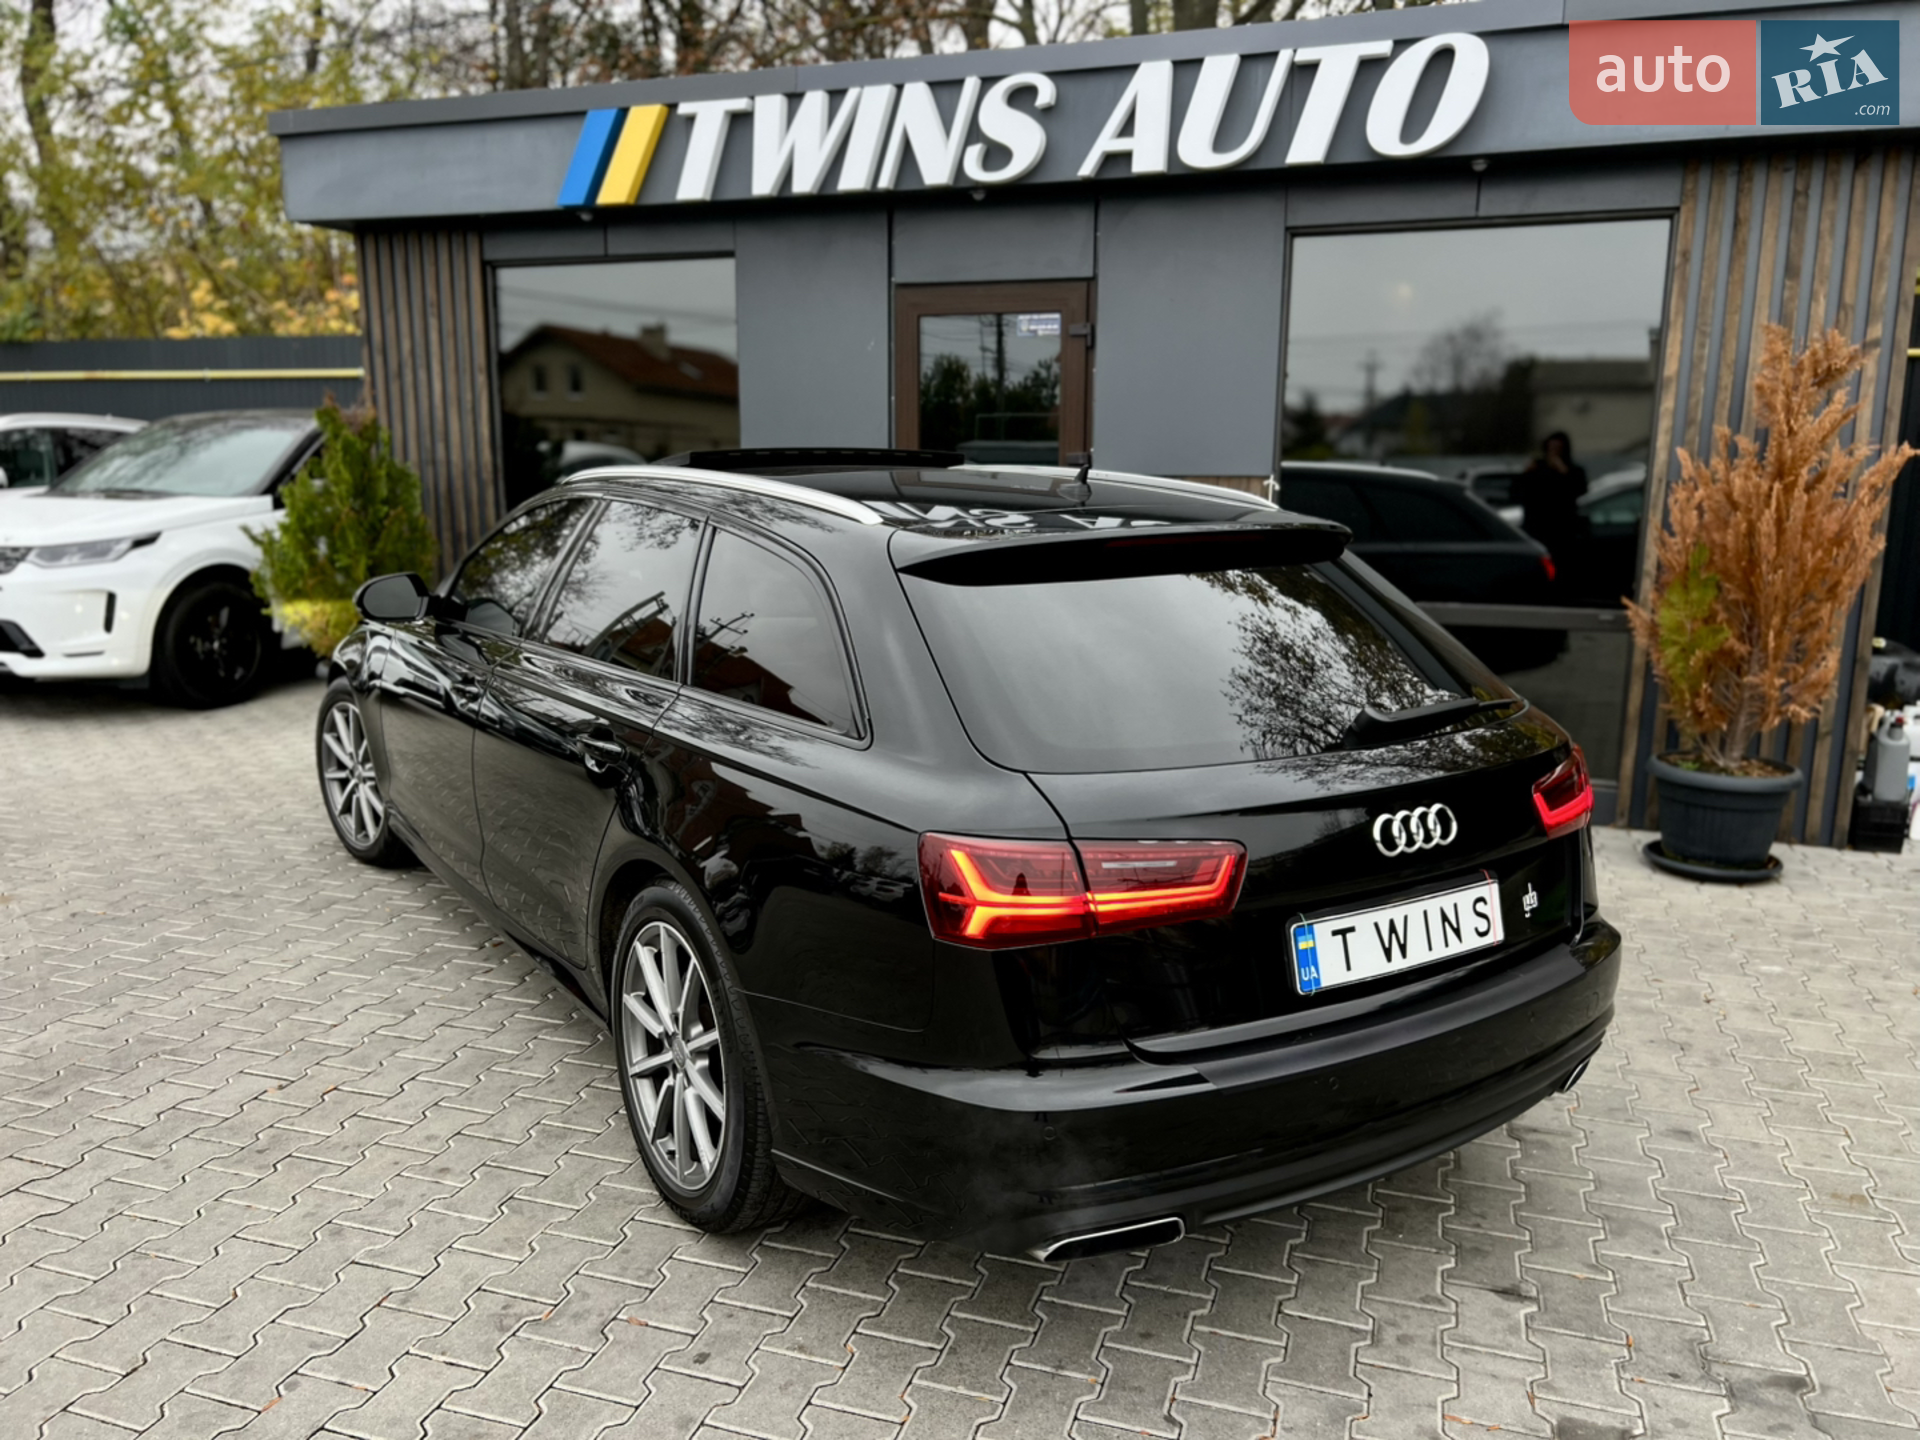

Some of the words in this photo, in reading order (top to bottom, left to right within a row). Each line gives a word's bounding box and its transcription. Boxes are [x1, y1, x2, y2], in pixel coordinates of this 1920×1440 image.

[676, 73, 1057, 201] TWINS
[1077, 32, 1491, 179] AUTO
[1331, 896, 1491, 972] TWINS
[1300, 965, 1319, 981] UA
